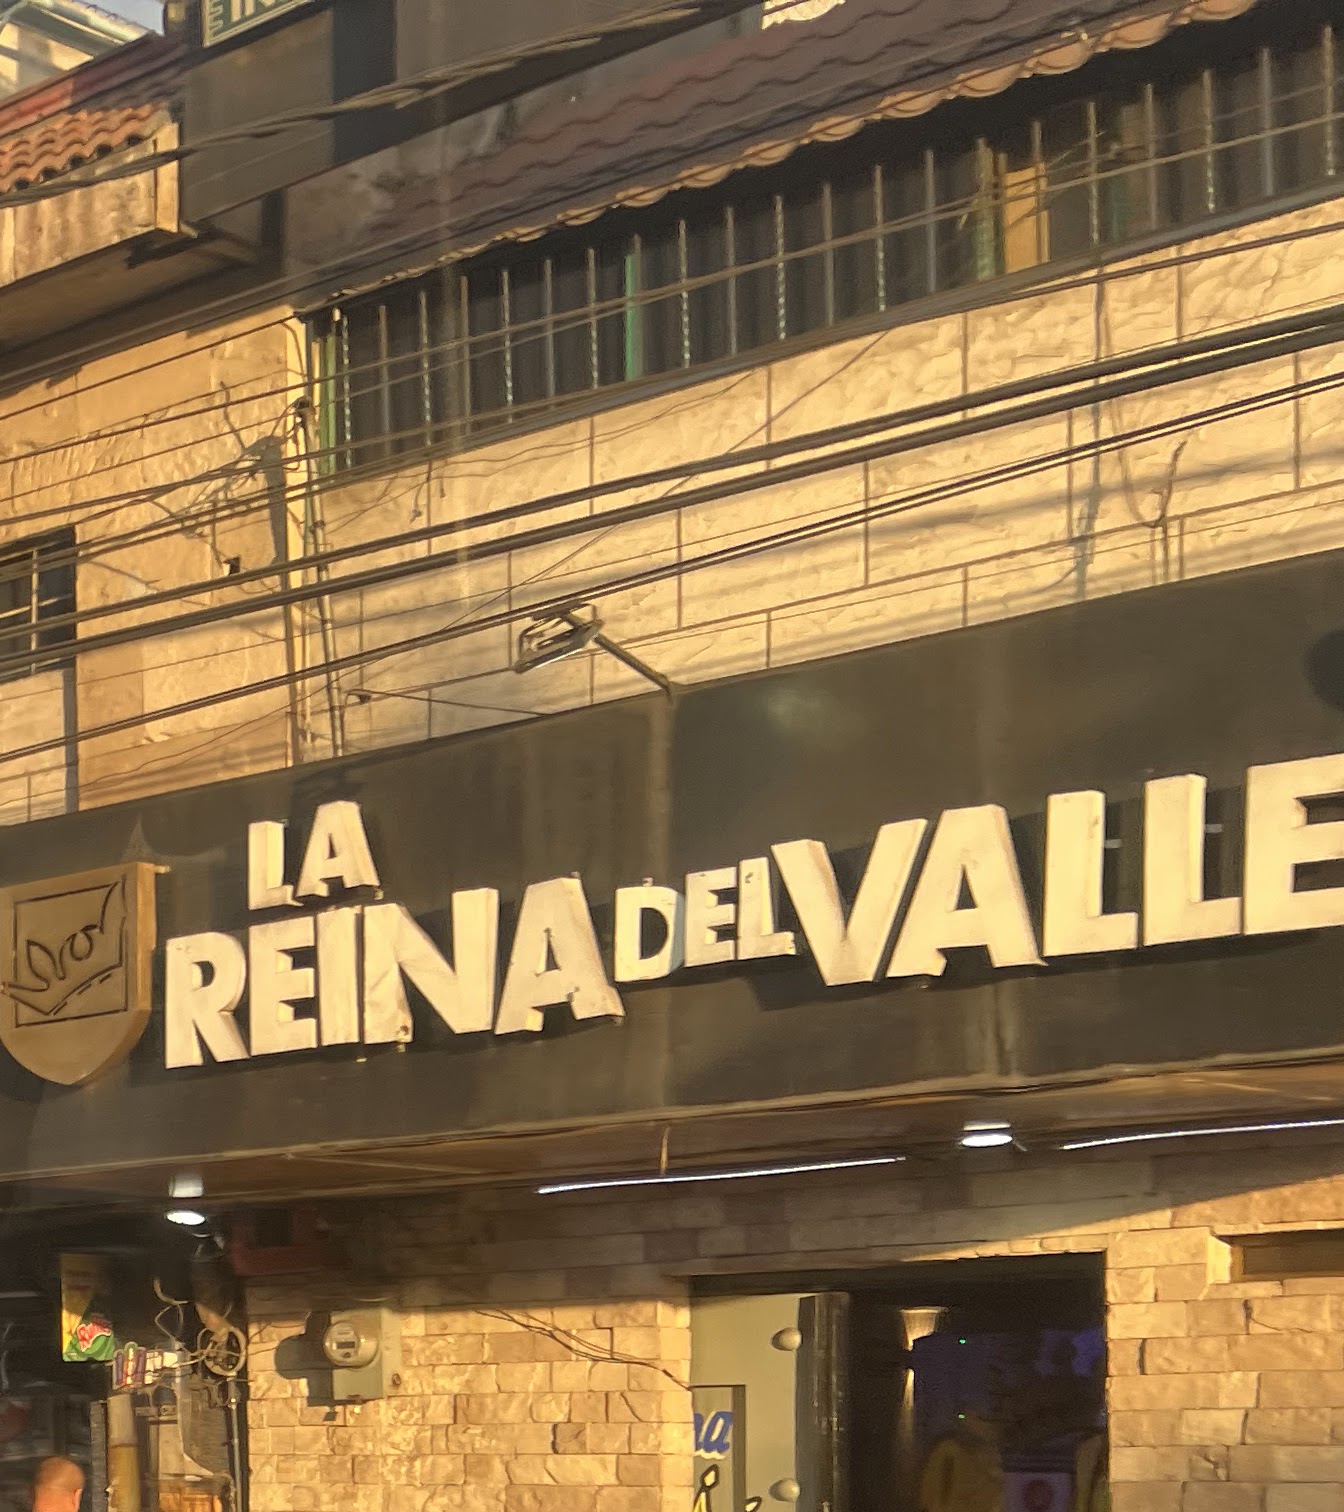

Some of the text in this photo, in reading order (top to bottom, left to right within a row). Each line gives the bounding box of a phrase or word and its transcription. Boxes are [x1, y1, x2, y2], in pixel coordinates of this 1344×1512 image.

[164, 753, 1344, 1070] REINA DEL VALLE
[248, 800, 381, 910] LA
